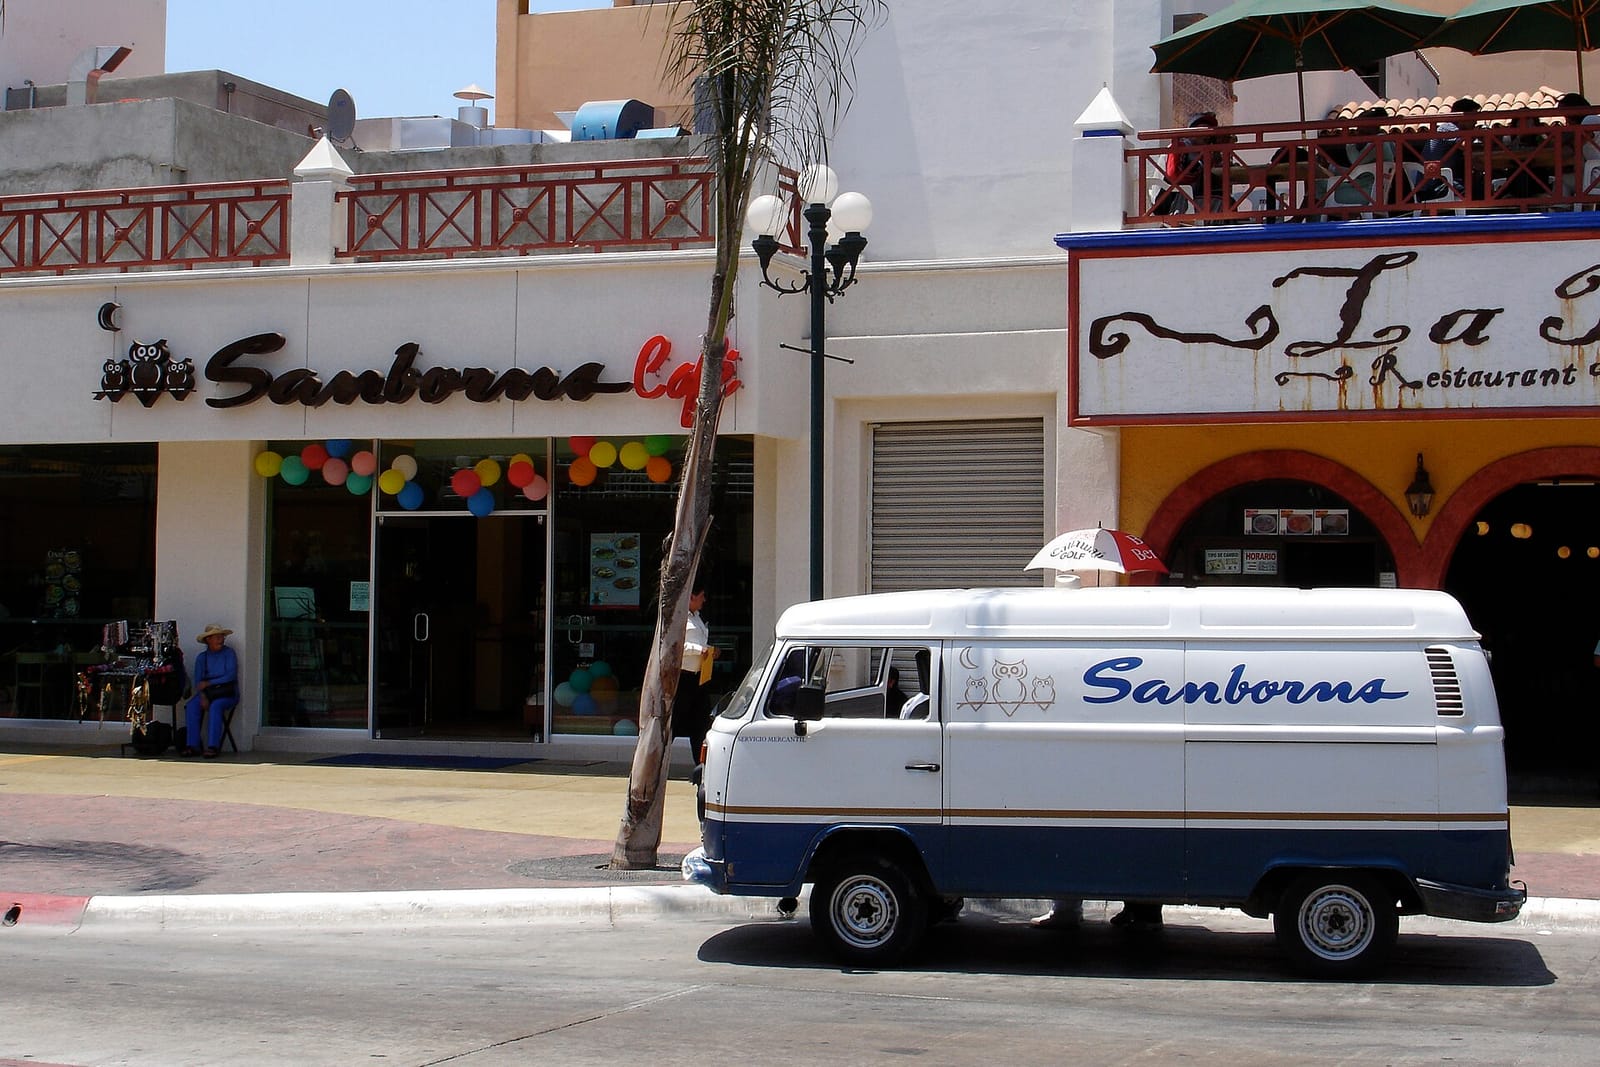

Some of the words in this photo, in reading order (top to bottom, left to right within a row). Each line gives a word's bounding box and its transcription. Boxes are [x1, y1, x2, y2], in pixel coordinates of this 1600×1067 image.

[204, 331, 633, 409] Sanborns
[1370, 346, 1577, 389] Restaurant
[1060, 551, 1086, 560] GOLF
[1245, 552, 1277, 561] HORARIO
[1083, 656, 1409, 705] Sanborns
